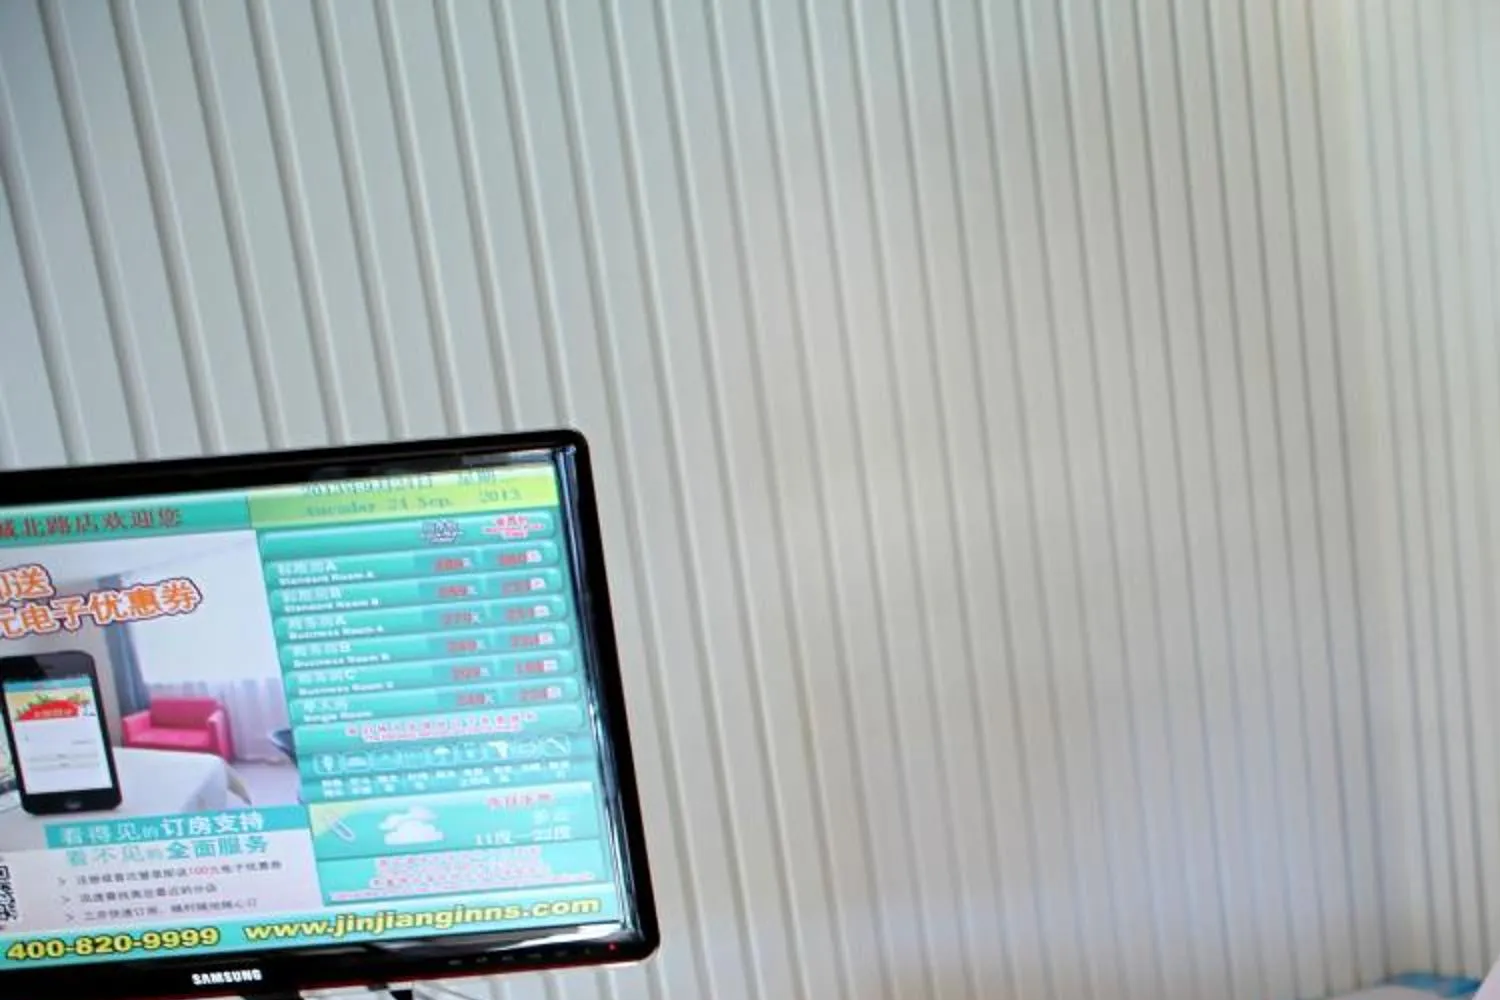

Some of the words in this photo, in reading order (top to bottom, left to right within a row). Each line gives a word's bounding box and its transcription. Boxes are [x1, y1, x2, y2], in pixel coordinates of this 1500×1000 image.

[62, 811, 264, 845] 看得见的订房支持
[66, 835, 269, 867] 看不见的全面服务
[7, 925, 219, 961] 400-820-9999
[245, 897, 601, 941] www.jinjianginns.com
[192, 969, 262, 985] SAMSUNG
